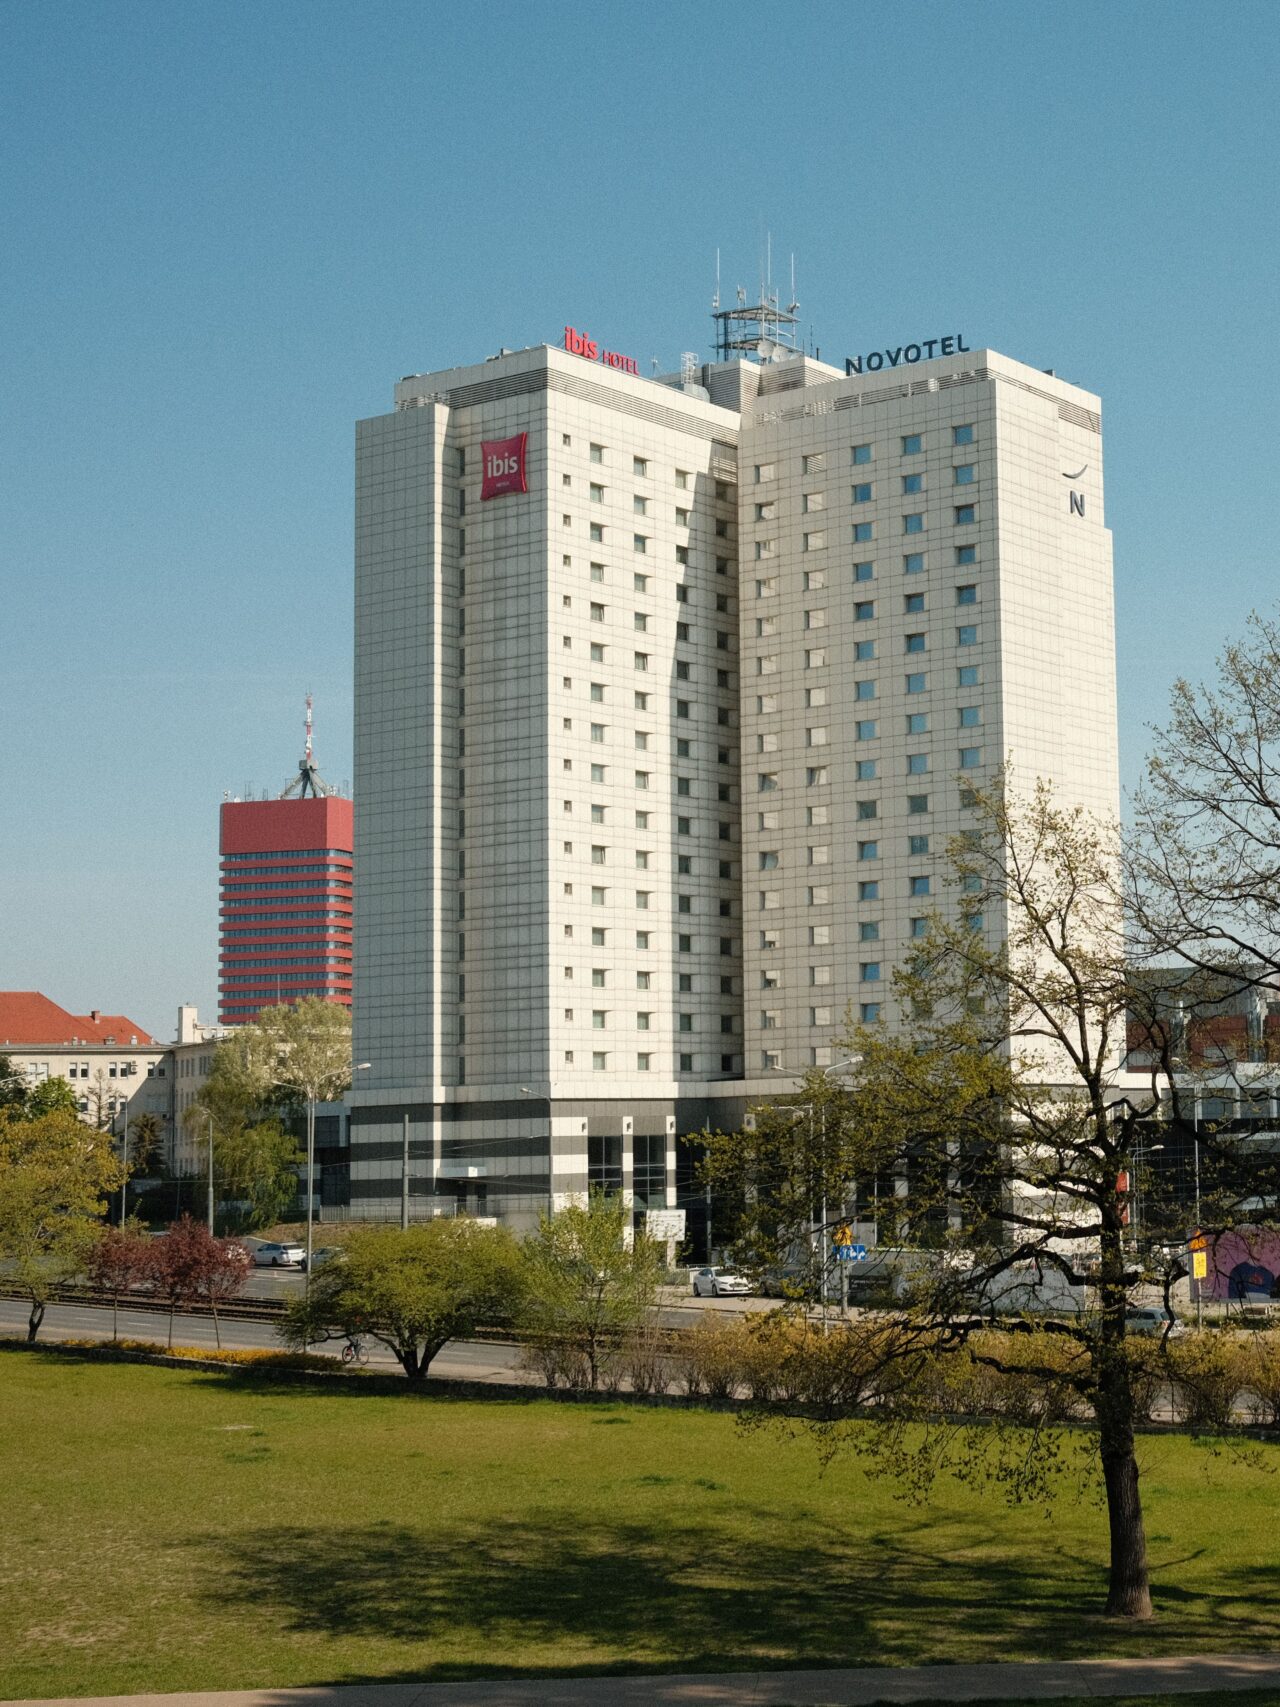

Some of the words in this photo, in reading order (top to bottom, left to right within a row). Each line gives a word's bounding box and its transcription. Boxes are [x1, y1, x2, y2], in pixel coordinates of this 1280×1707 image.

[565, 326, 599, 361] ibis
[602, 349, 640, 376] HOTEL
[845, 334, 970, 377] NOVOTEL
[487, 452, 518, 479] ibis
[1070, 490, 1085, 517] N
